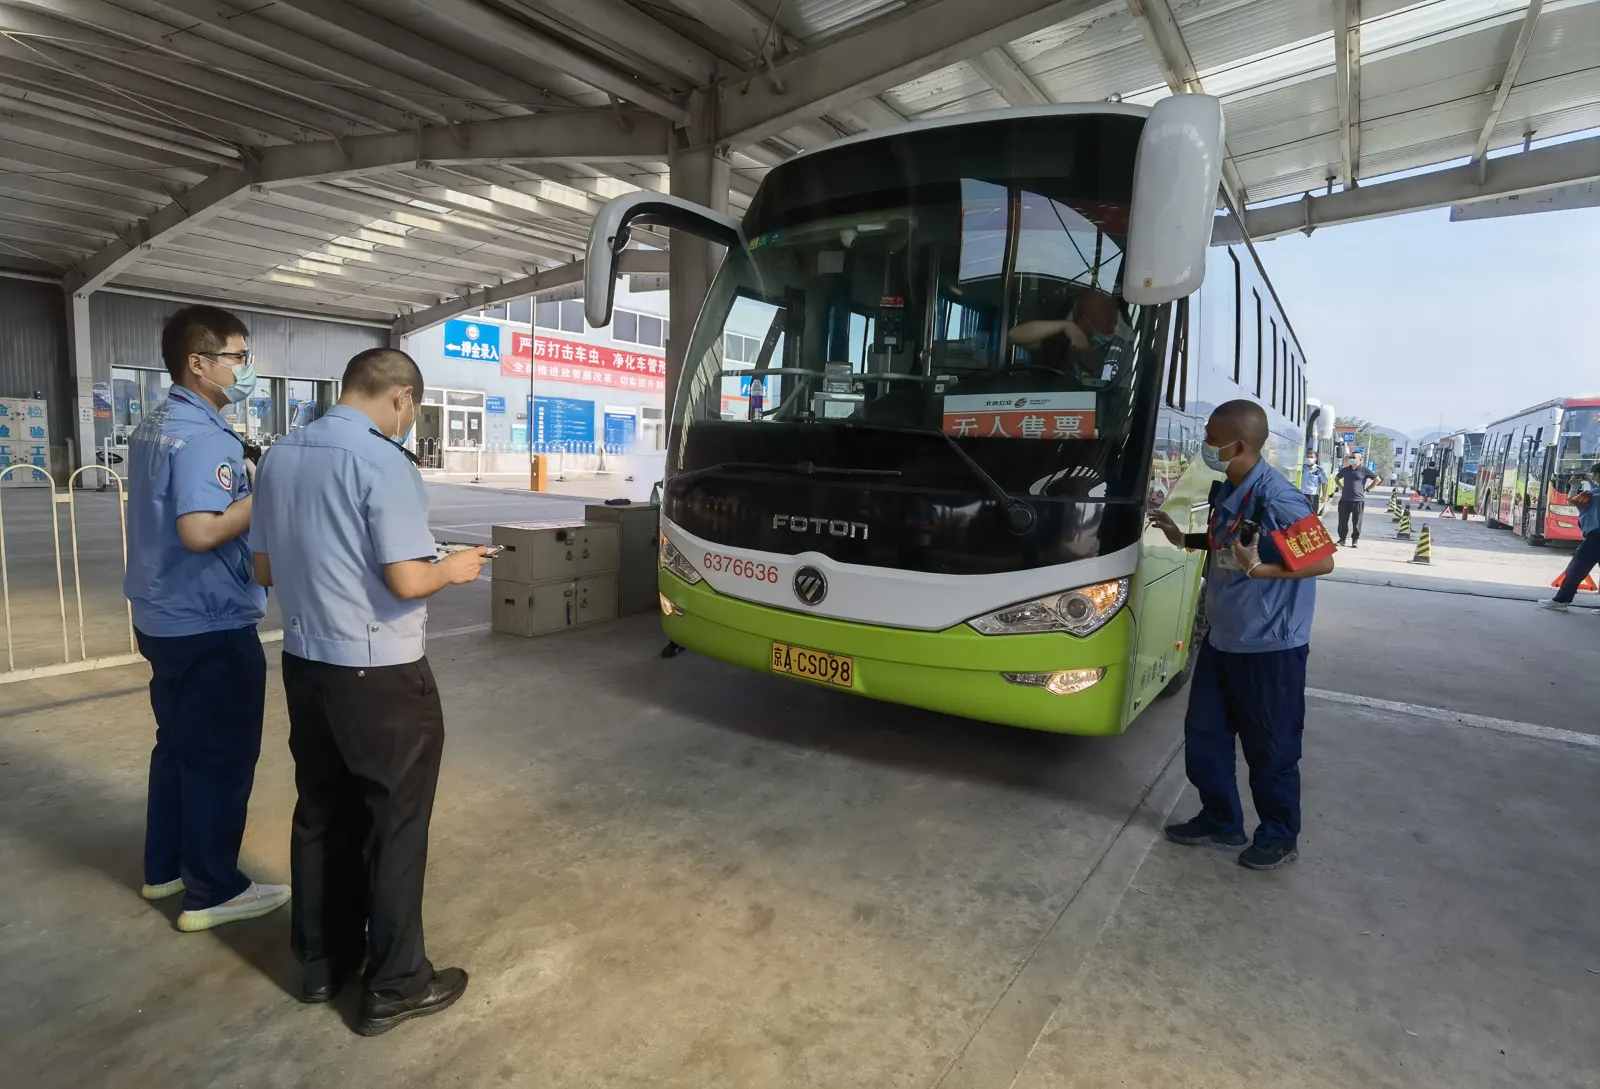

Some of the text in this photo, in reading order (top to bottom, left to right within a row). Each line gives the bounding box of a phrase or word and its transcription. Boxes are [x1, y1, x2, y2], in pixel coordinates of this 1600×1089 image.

[952, 415, 1084, 439] 无人售票
[772, 514, 868, 540] FOTON
[703, 552, 779, 583] 6376636
